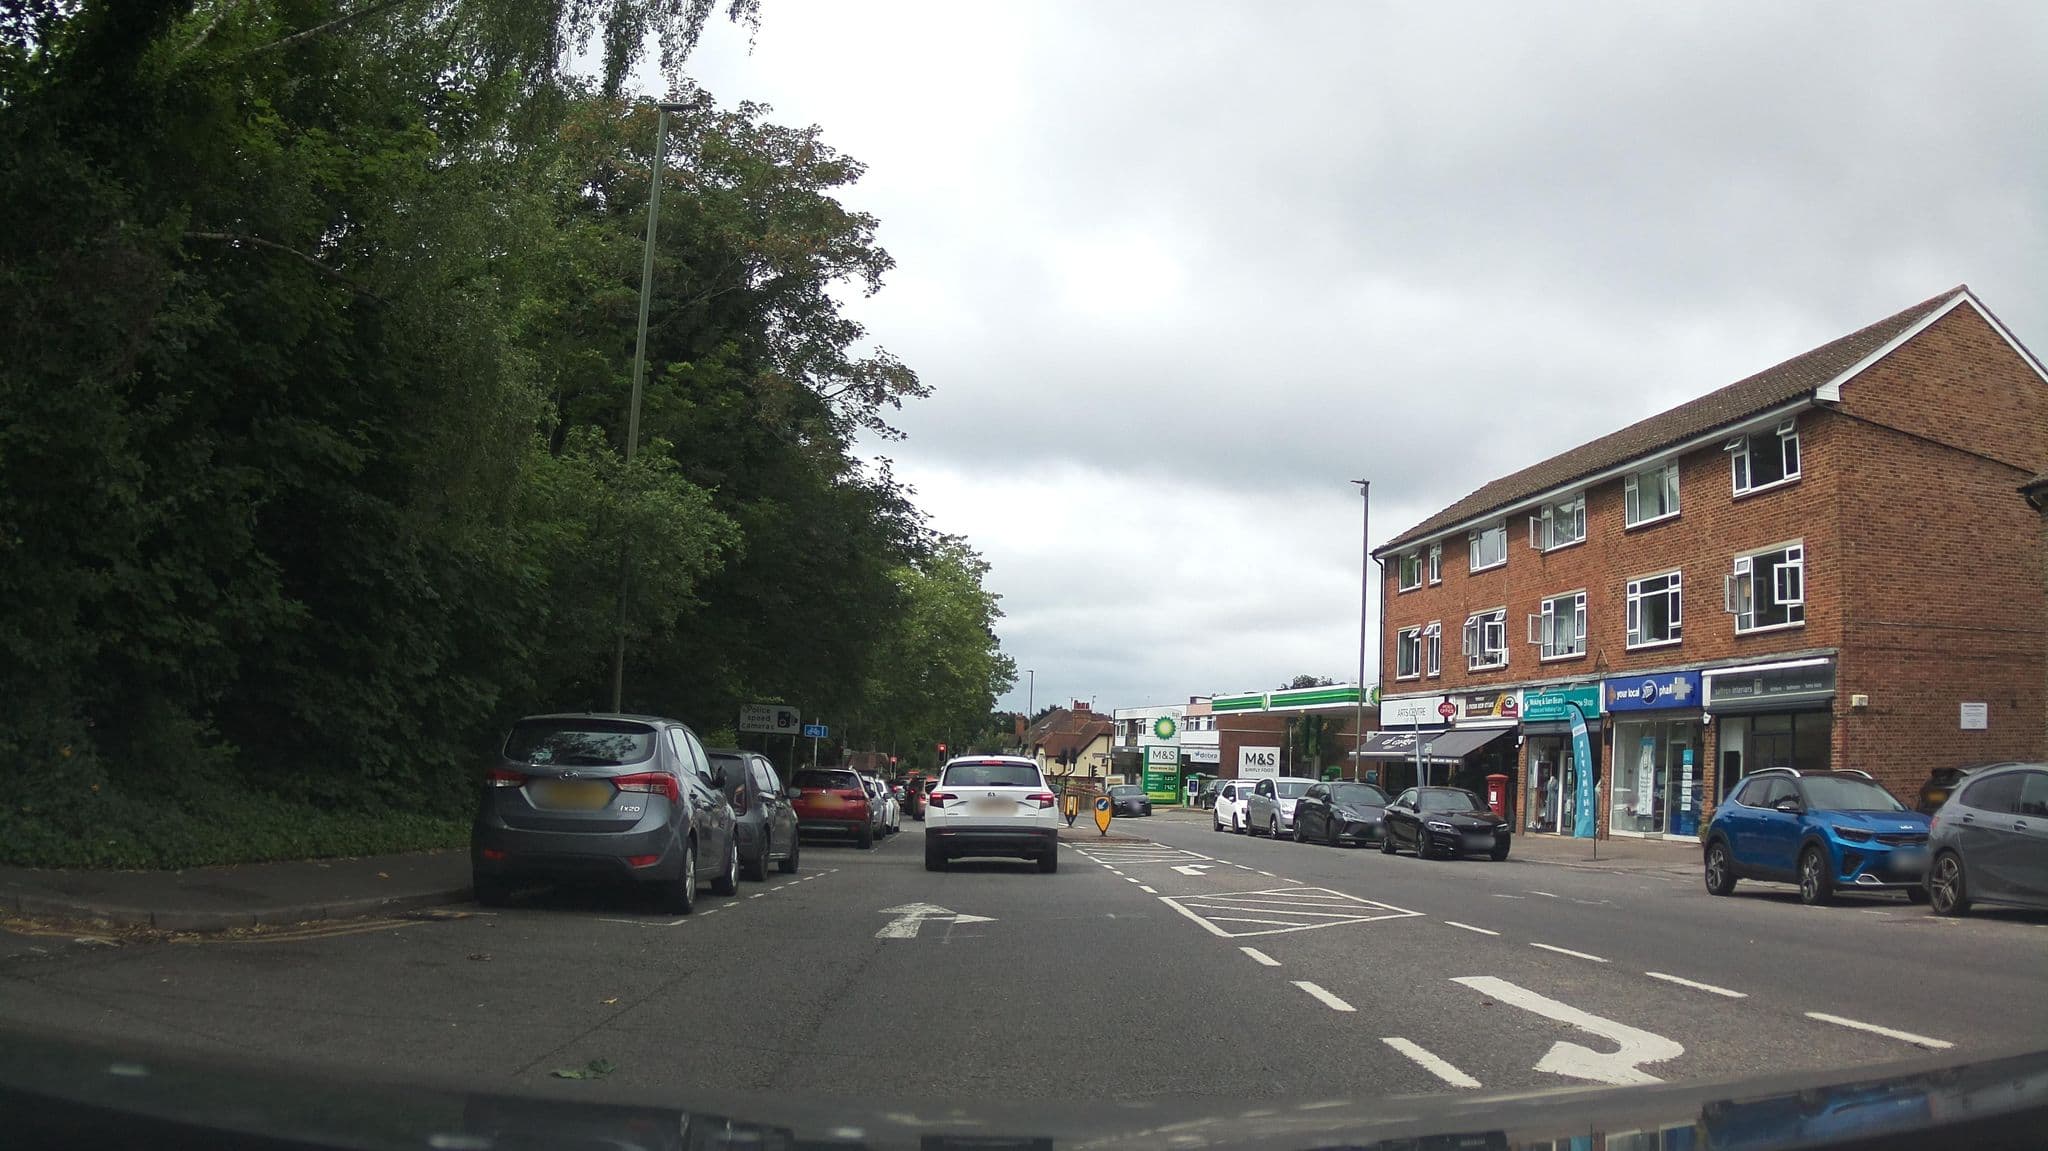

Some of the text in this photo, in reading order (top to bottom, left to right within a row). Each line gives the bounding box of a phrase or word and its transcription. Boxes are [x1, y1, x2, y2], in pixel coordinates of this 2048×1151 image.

[1616, 690, 1628, 700] your
[1628, 688, 1640, 697] local
[743, 704, 771, 714] Police
[747, 714, 771, 722] speed
[741, 722, 775, 730] cameras
[1152, 750, 1175, 760] M&S
[1245, 752, 1275, 766] M&S
